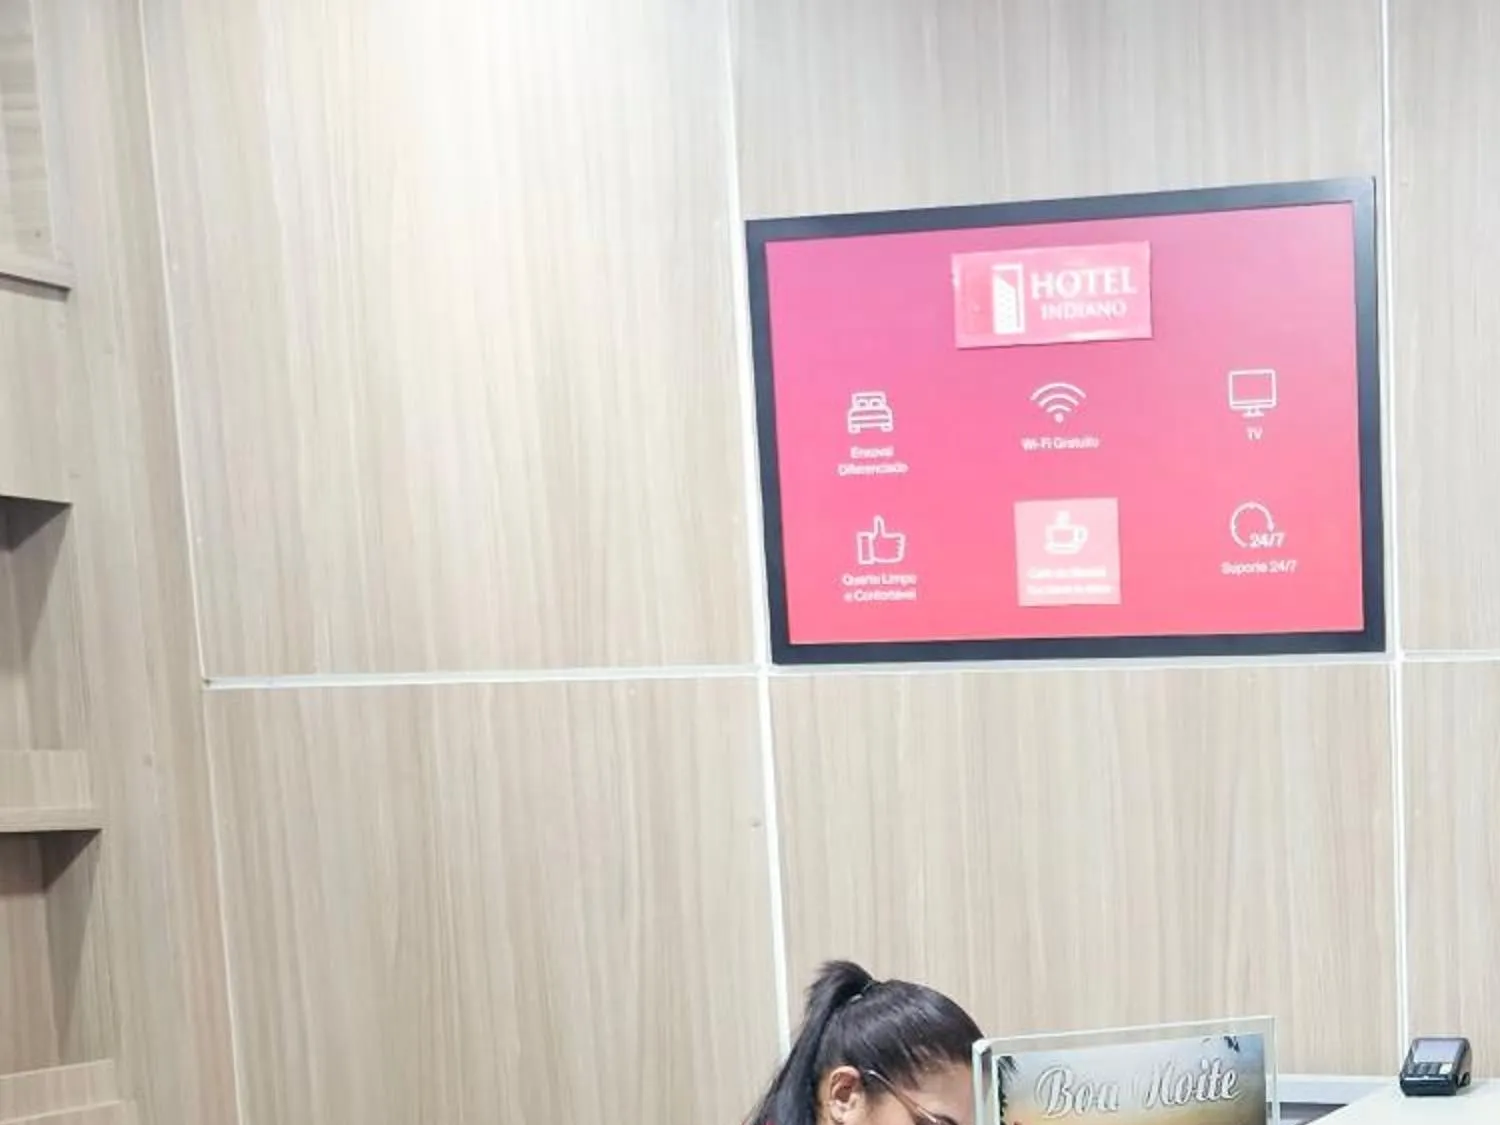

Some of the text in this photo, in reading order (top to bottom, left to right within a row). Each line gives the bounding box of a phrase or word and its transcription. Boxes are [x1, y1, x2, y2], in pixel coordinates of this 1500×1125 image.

[1030, 265, 1138, 300] HOTEL
[1040, 299, 1128, 321] INDIANO
[1246, 426, 1264, 441] TV
[1020, 437, 1053, 452] Wi-Fi
[1249, 532, 1285, 548] 24/7
[1220, 558, 1297, 576] Suporte 24/7
[1035, 1058, 1240, 1119] Boa Noite
